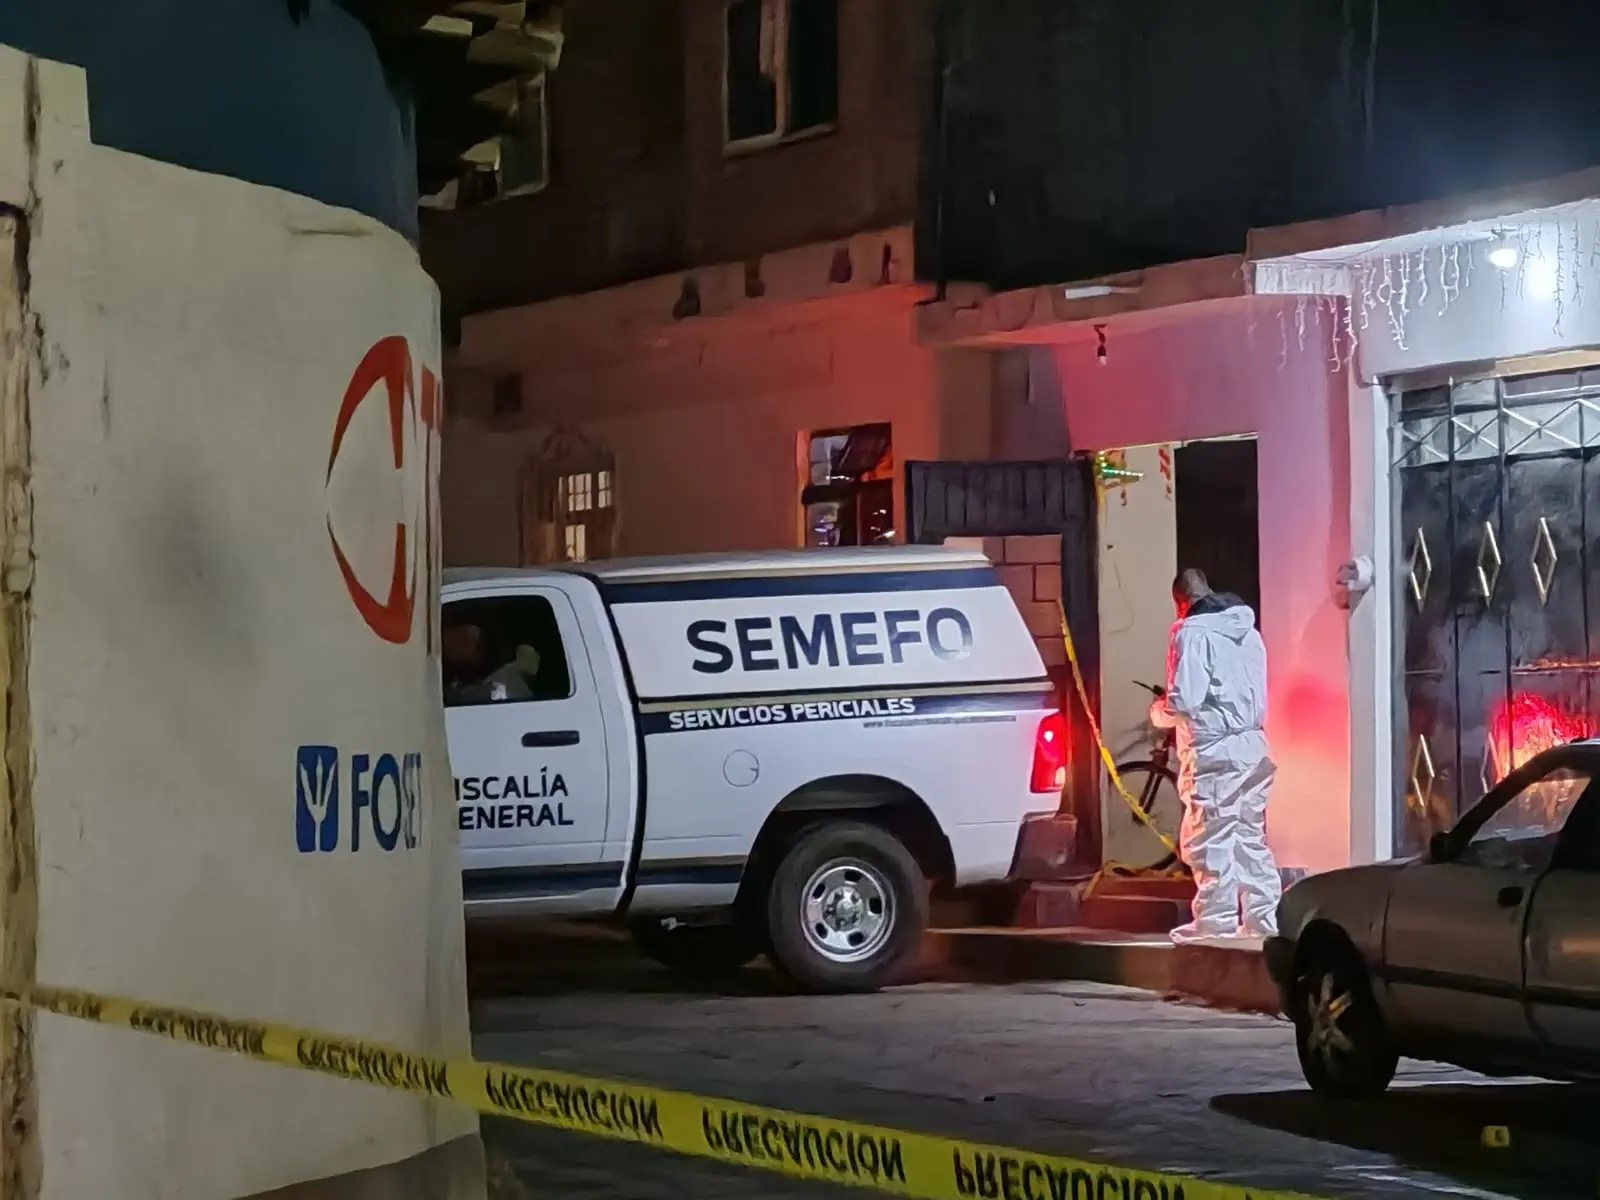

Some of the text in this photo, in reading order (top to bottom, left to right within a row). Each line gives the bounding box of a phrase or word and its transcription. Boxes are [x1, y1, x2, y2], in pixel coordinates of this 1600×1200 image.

[686, 607, 973, 673] SEMEFO
[669, 698, 916, 729] SERVICIOS PERICIALES
